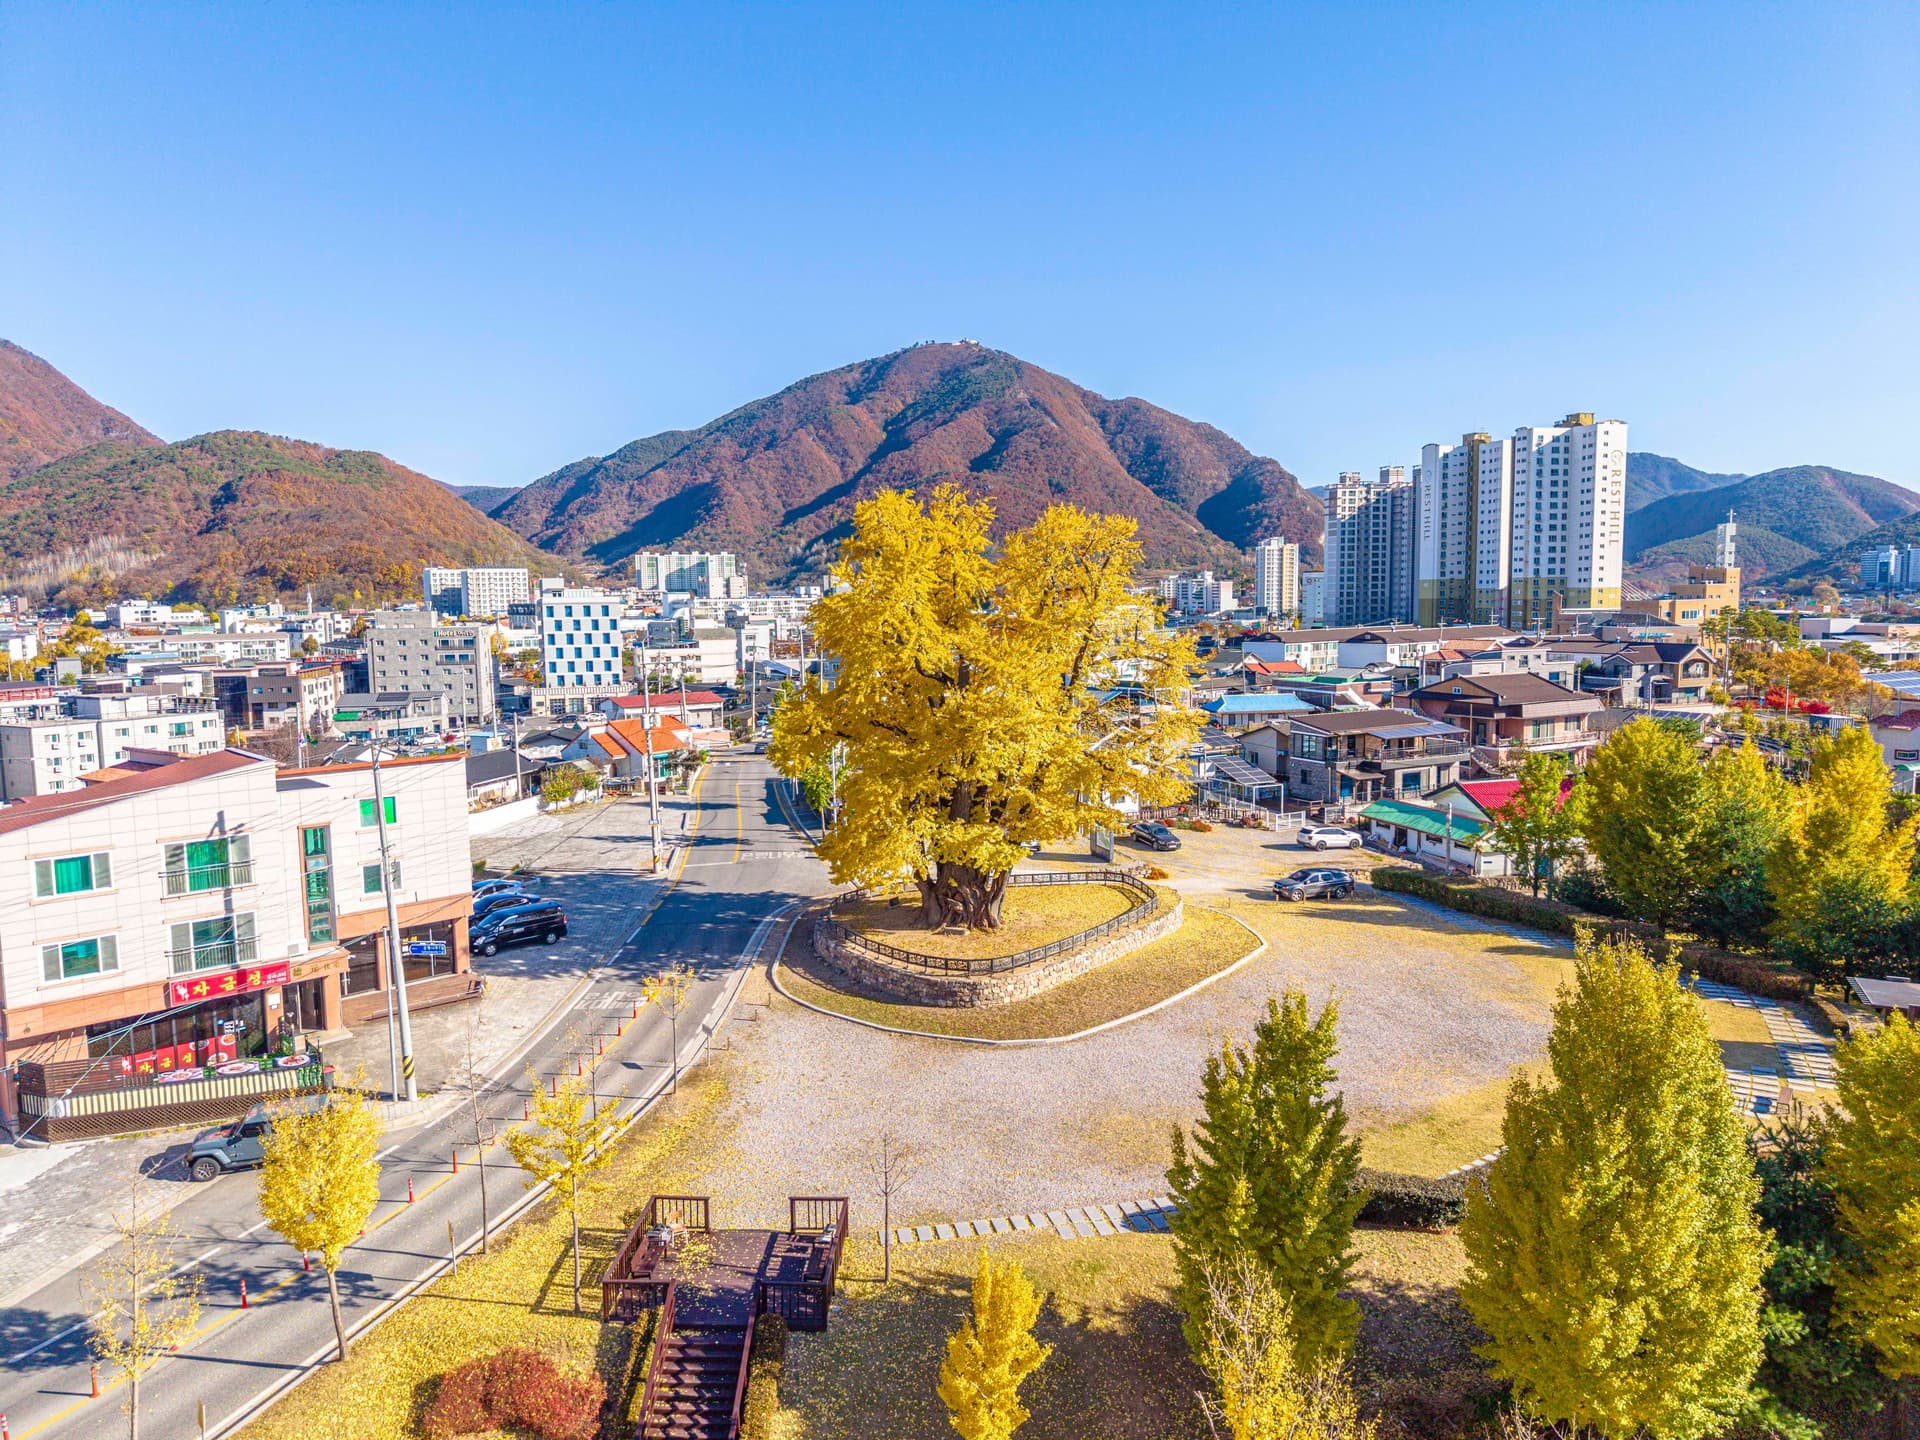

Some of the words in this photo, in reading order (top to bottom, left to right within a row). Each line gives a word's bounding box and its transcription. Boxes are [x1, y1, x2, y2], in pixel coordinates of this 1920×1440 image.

[1611, 469, 1622, 506] REST
[1609, 511, 1620, 545] HILL
[192, 970, 261, 997] 자금성
